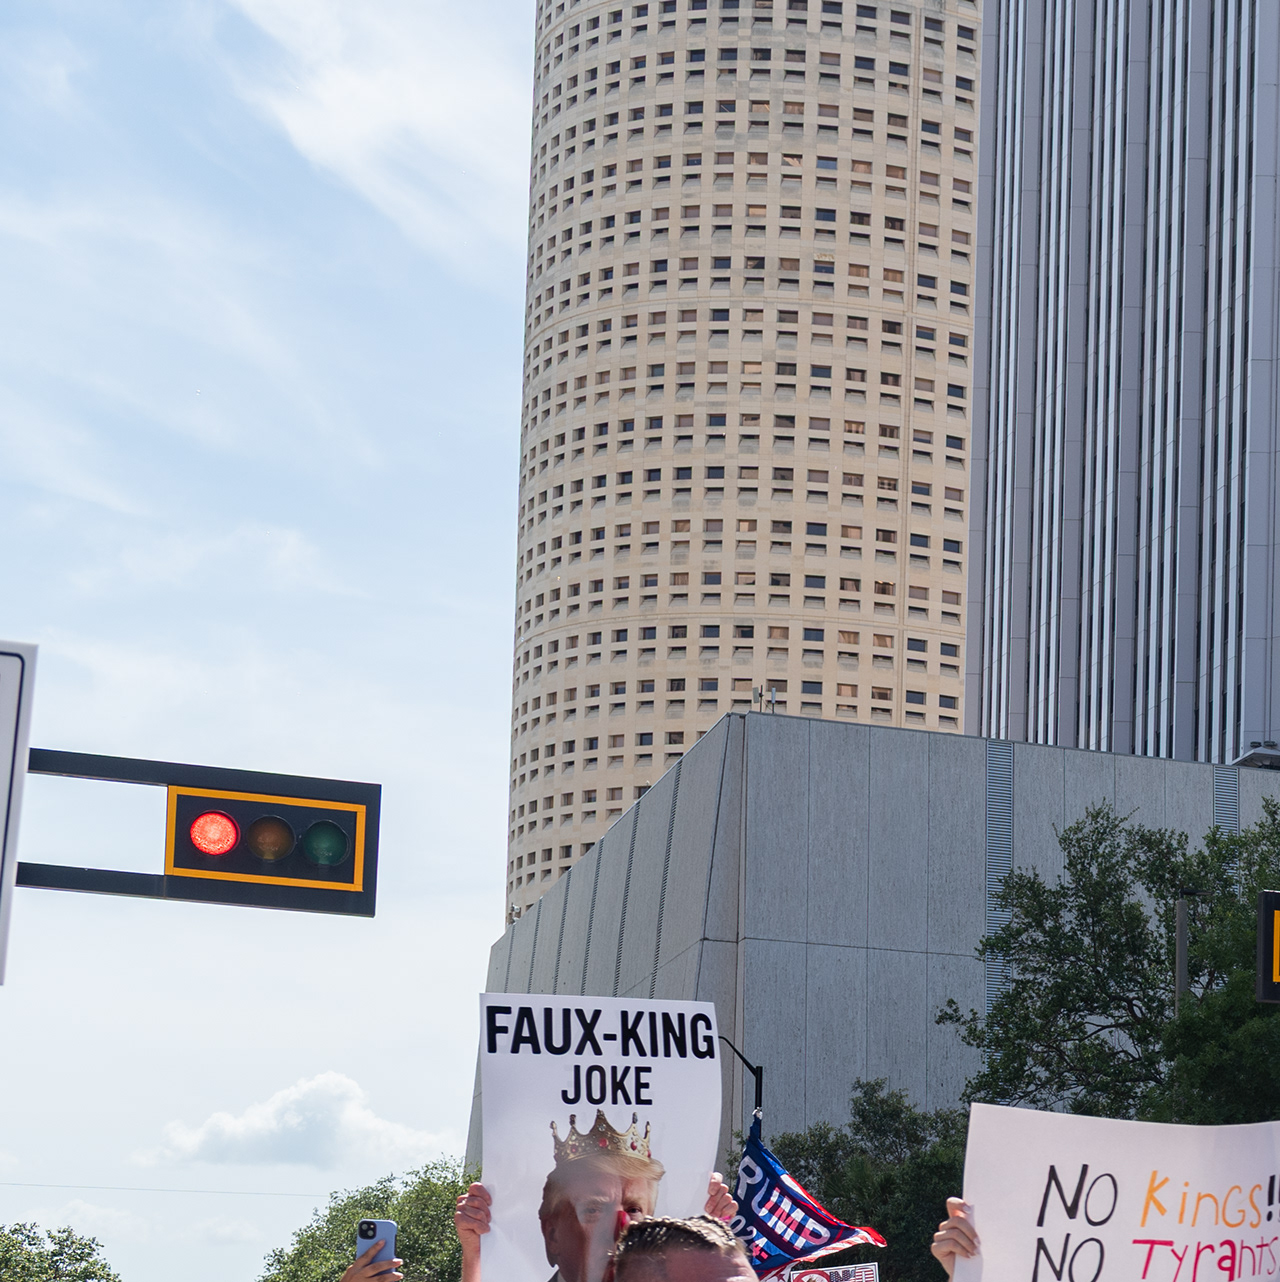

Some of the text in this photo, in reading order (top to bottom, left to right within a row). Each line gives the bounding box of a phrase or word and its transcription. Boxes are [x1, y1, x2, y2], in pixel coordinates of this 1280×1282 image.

[486, 1005, 715, 1059] FAUX-KING
[561, 1064, 654, 1106] JOKE
[1037, 1164, 1118, 1227] NO
